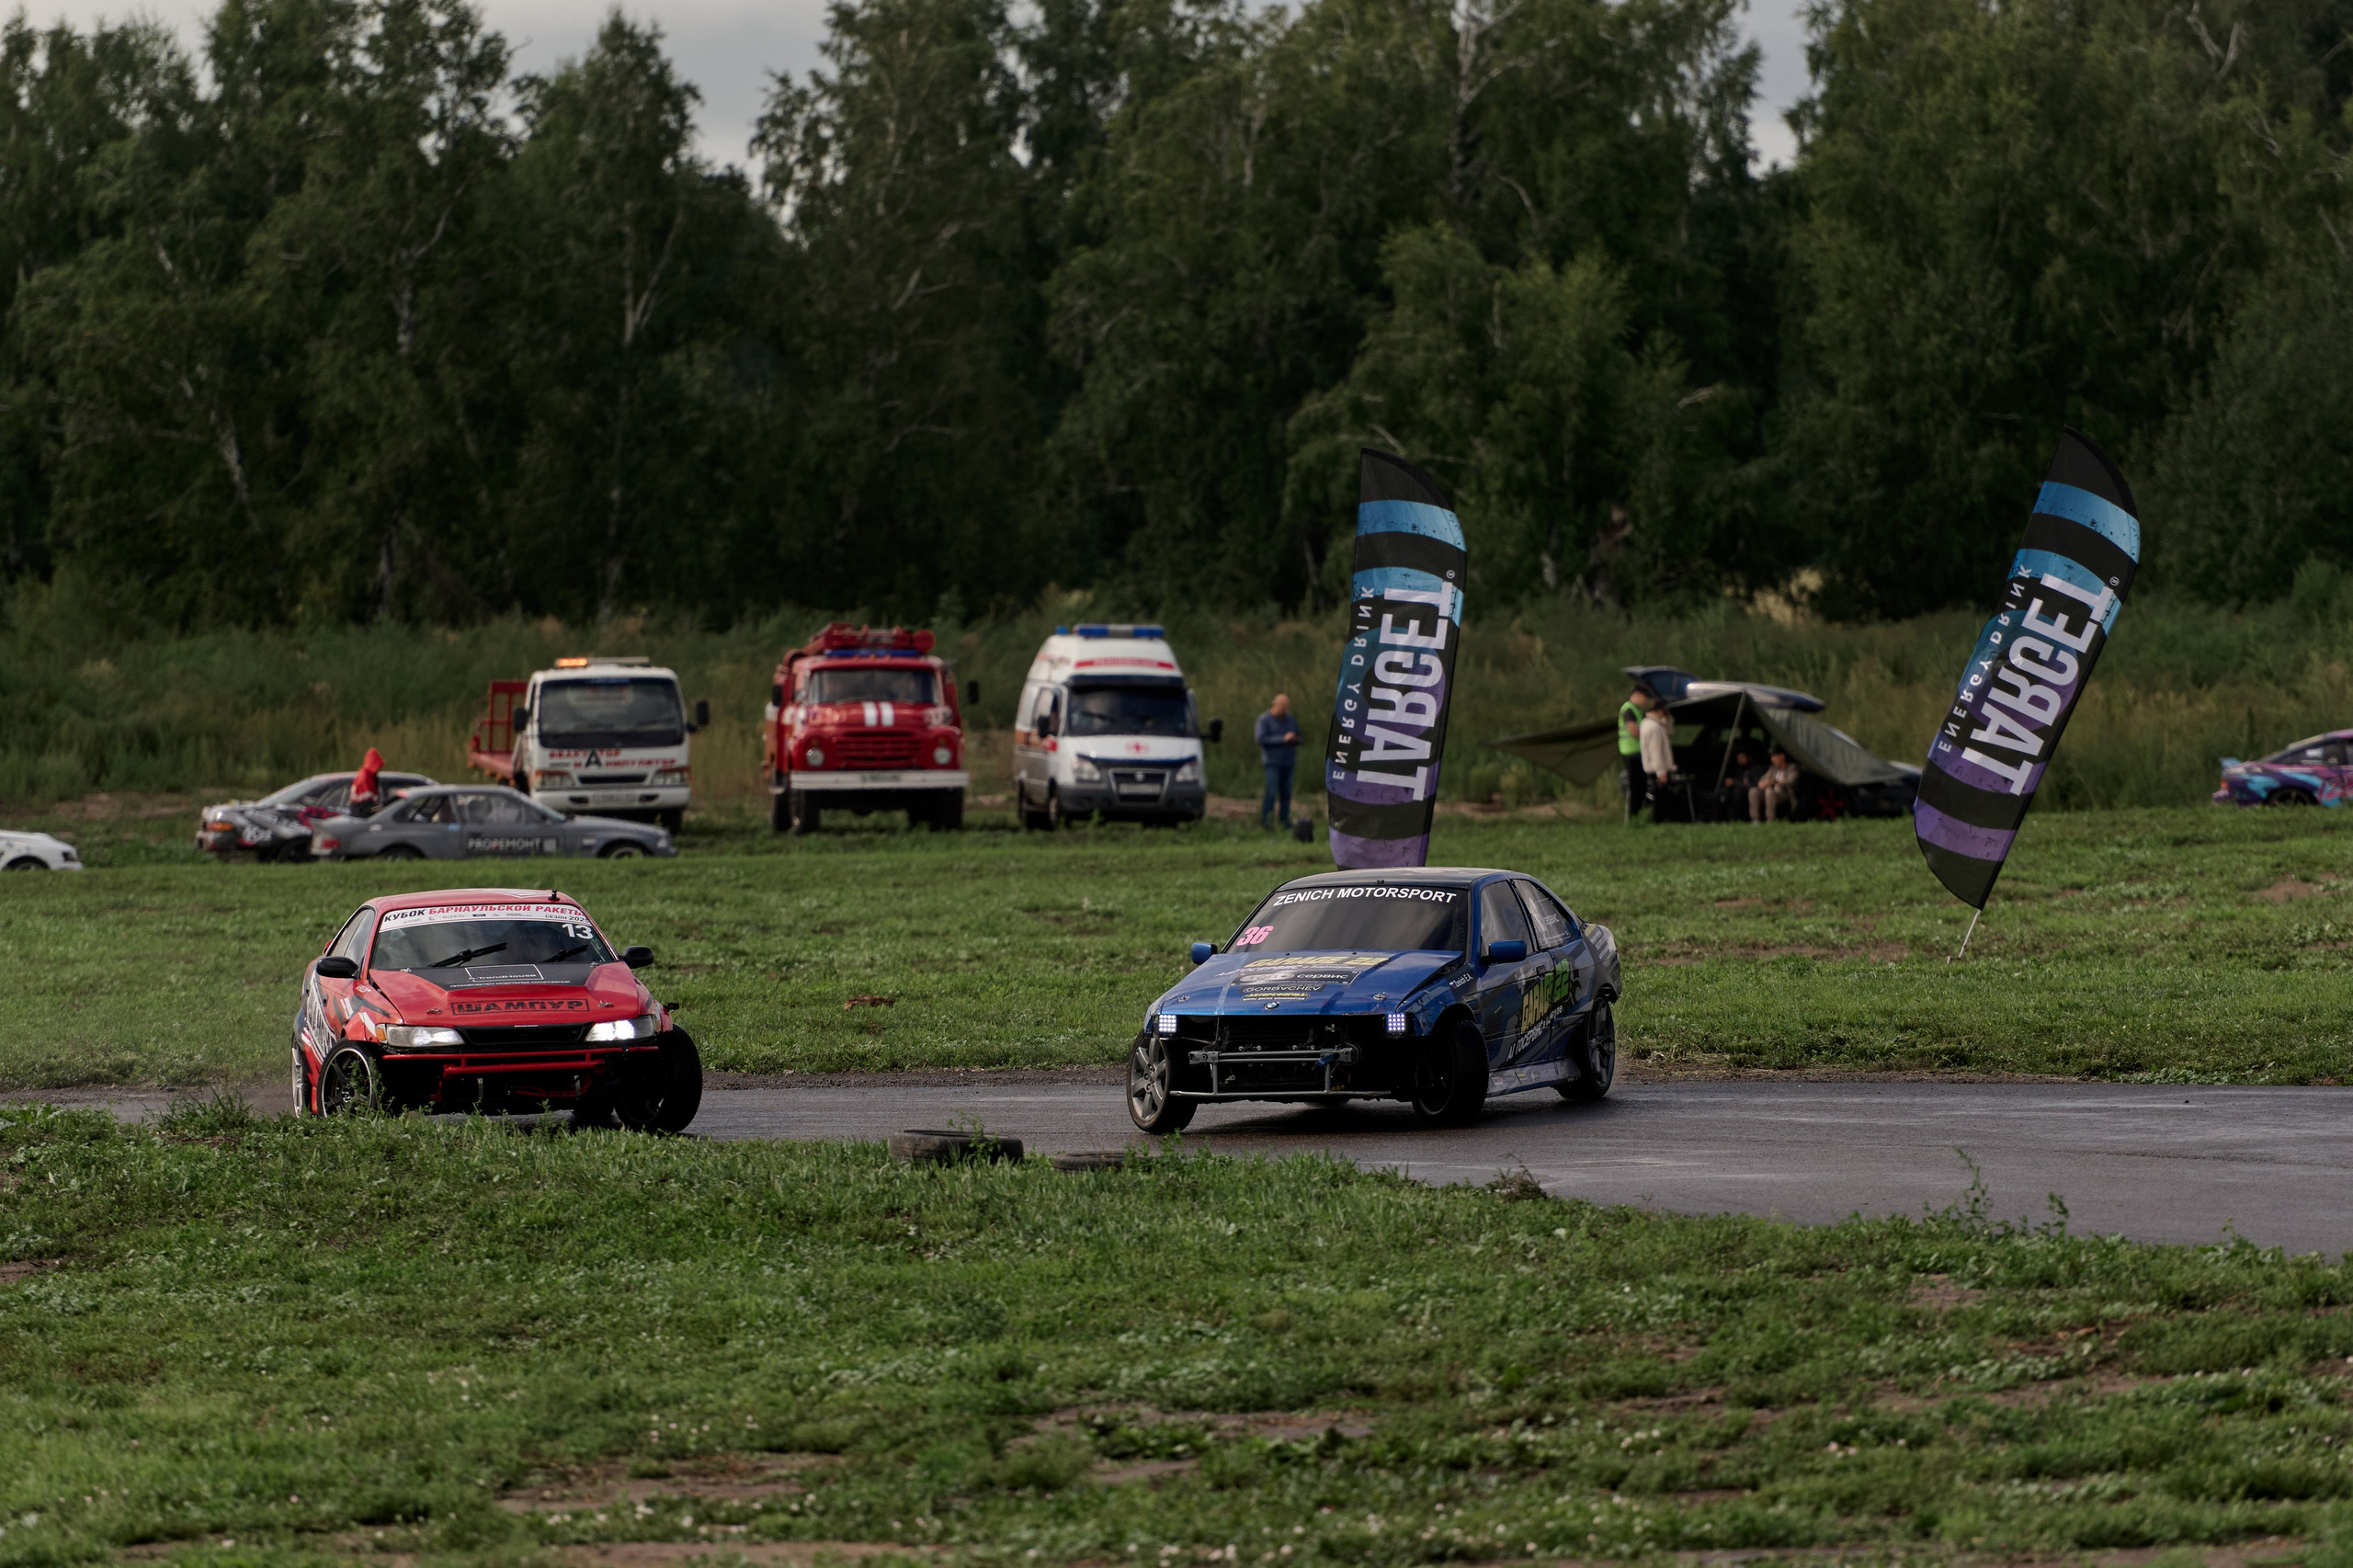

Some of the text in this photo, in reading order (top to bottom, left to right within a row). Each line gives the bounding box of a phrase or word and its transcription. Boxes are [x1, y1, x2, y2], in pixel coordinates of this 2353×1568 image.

[1273, 887, 1457, 906] ZENICH MOTORSPORT
[383, 909, 426, 923] КУБОК
[428, 904, 531, 915] БАРНАУЛЬСКОЙ
[562, 923, 594, 939] 13
[1236, 926, 1274, 947] 36
[457, 1000, 584, 1012] ШАМПУР
